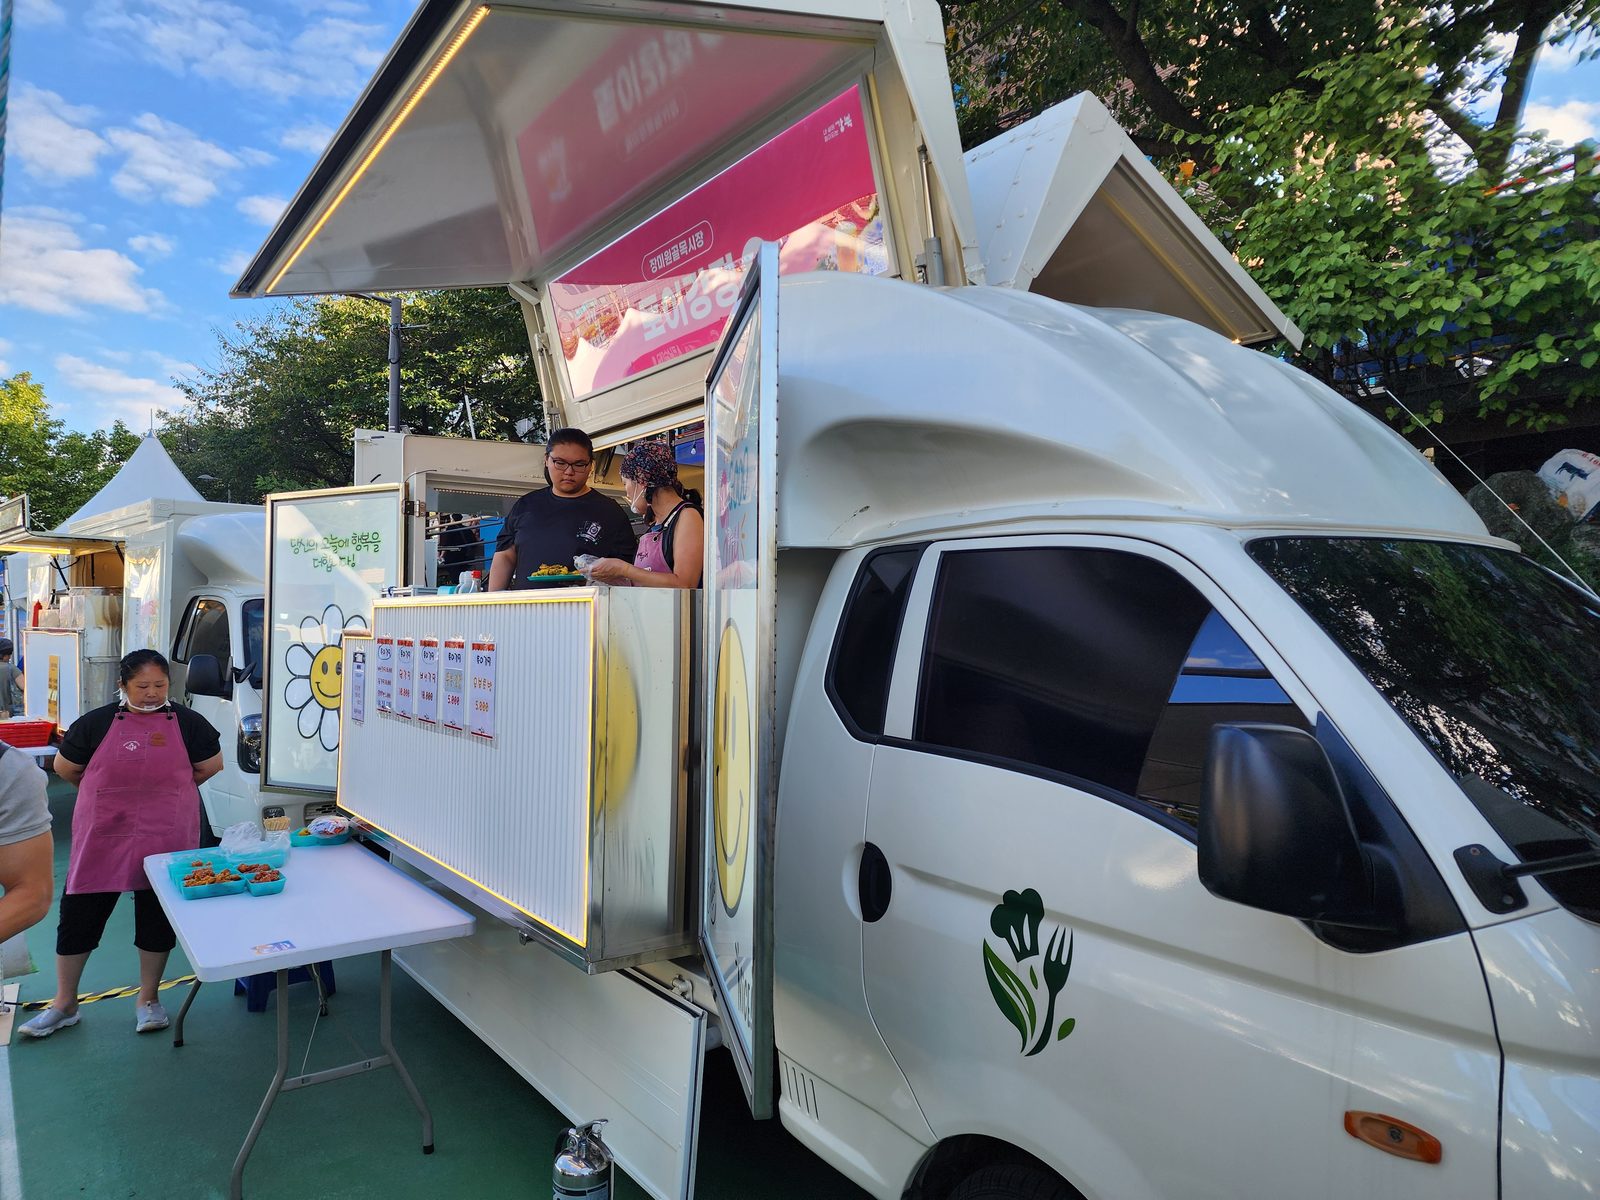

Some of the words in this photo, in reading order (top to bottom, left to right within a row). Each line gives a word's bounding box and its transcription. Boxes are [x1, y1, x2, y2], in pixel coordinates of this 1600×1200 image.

[648, 230, 704, 274] 장미원골목시장
[290, 538, 318, 555] 당신의
[320, 534, 349, 554] 오늘에
[351, 531, 381, 553] 행복을
